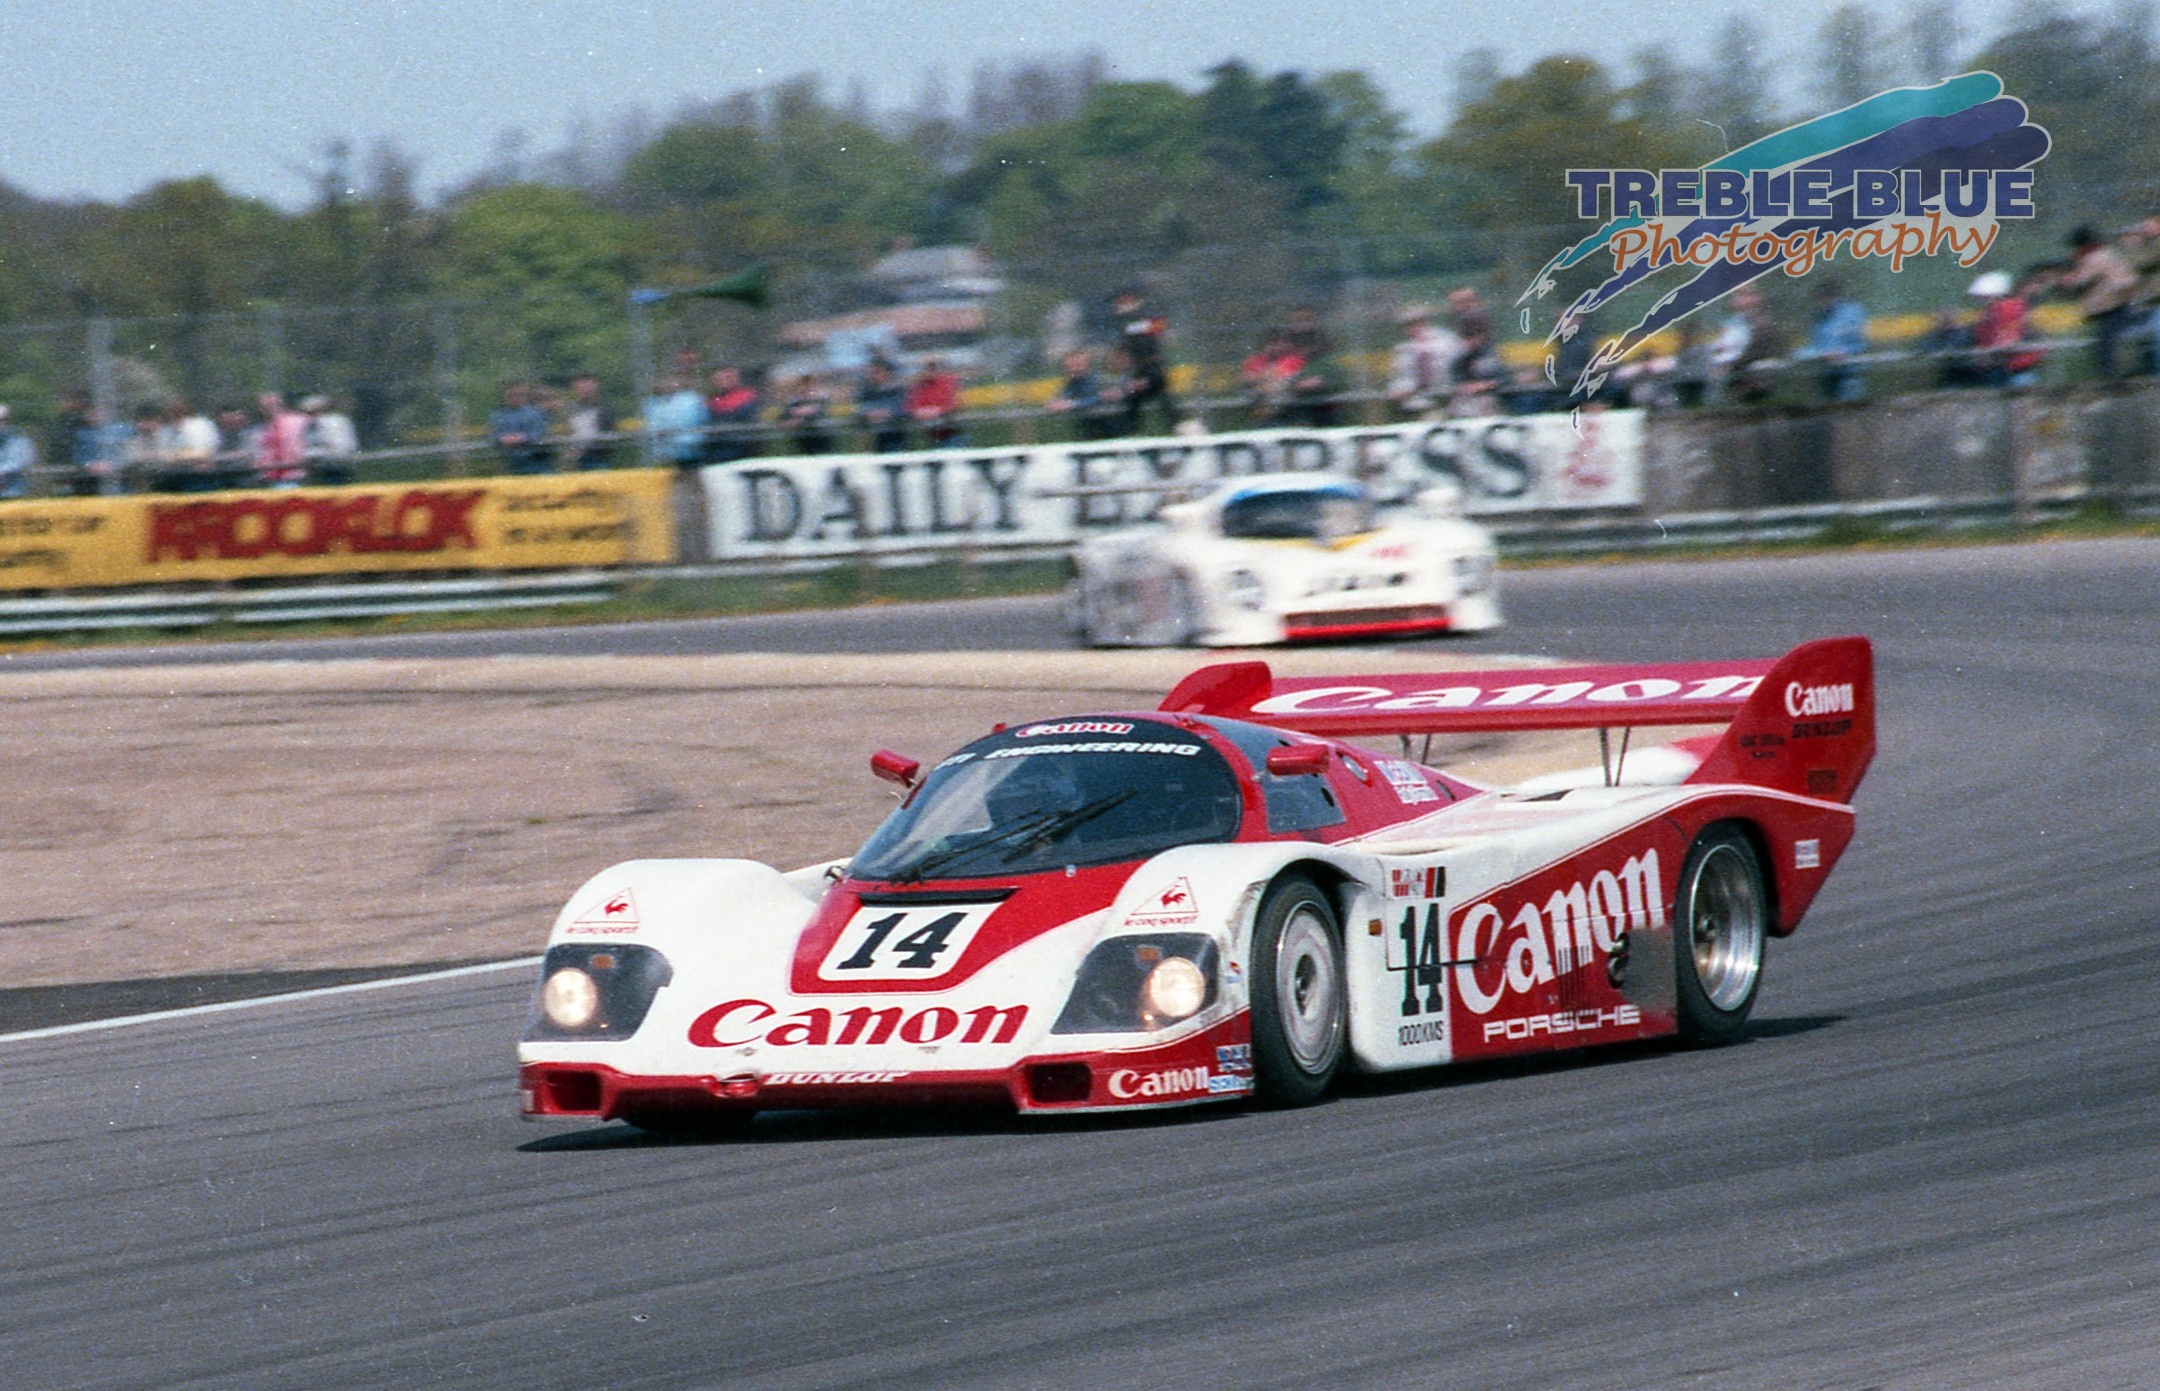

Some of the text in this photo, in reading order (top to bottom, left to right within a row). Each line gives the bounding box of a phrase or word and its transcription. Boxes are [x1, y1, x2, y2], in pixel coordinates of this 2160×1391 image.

[737, 454, 1030, 541] DAILY
[1250, 675, 1766, 714] Canon
[1785, 681, 1854, 717] Canon
[1016, 722, 1134, 738] Canon
[984, 742, 1201, 759] ENGINEERING
[837, 911, 968, 970] 14
[1455, 847, 1666, 1014] Canon
[1399, 902, 1443, 1017] 14
[688, 999, 1029, 1048] Canon
[1483, 1004, 1642, 1044] PORSCHE
[763, 1072, 911, 1086] DUNLOP
[1108, 1066, 1210, 1099] Canon
